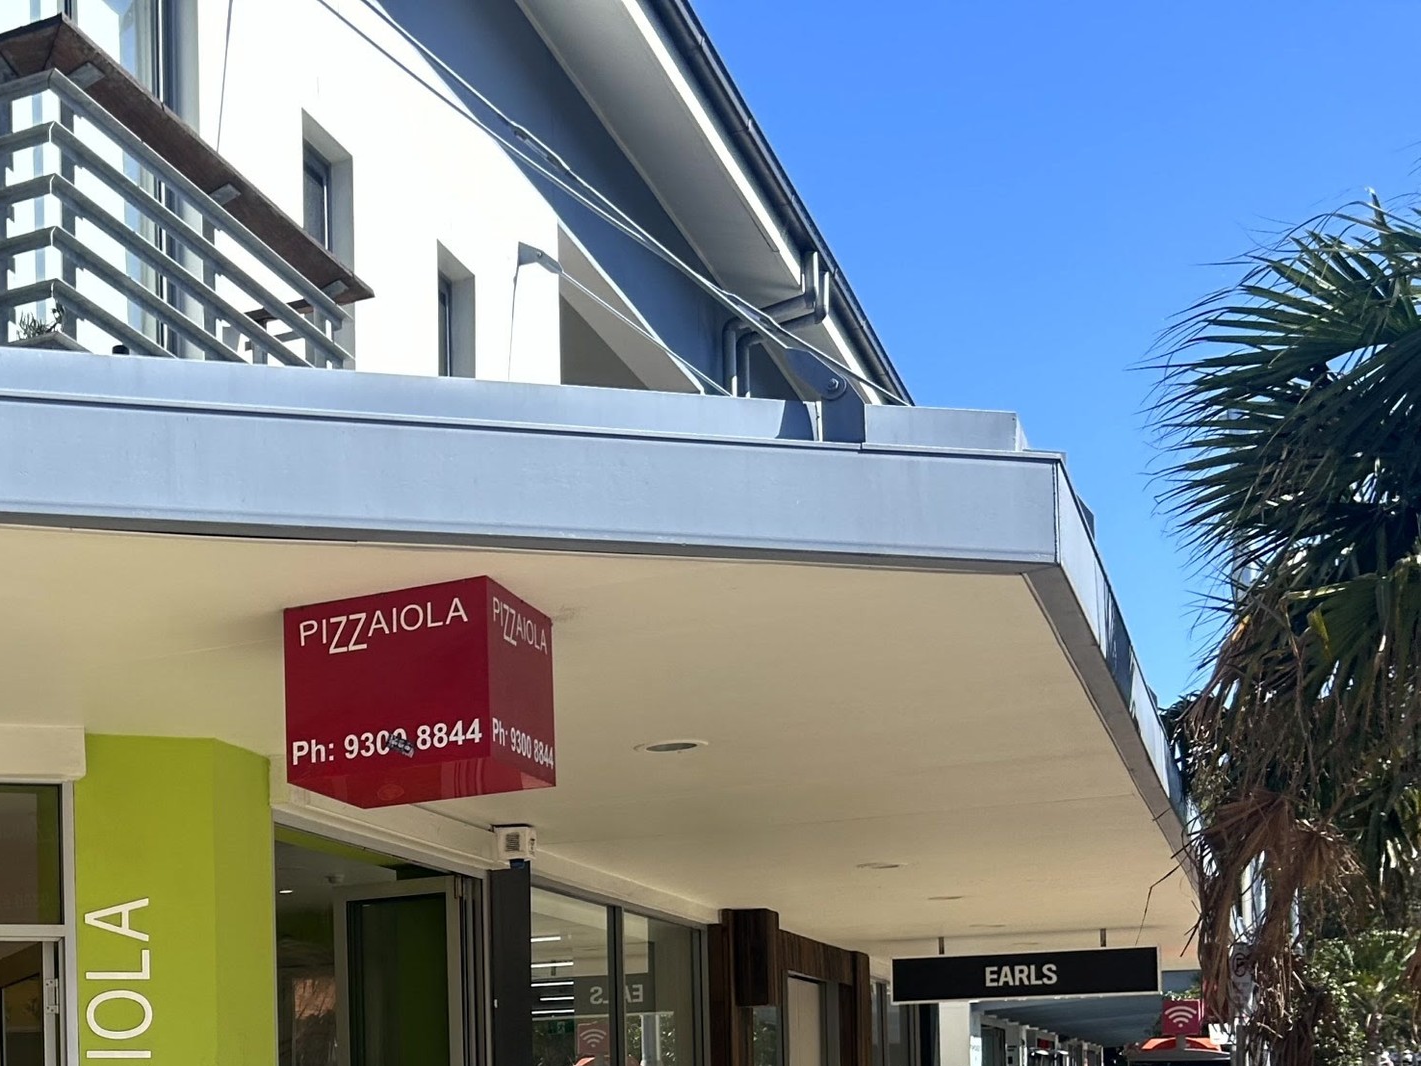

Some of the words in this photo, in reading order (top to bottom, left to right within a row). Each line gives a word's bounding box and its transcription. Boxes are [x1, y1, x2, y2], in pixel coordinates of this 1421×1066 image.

[298, 597, 469, 654] PIZZAIOLA
[492, 596, 548, 655] PIZZAIOLA
[291, 738, 335, 766] Ph:
[415, 717, 483, 750] 8844
[510, 726, 532, 759] 9300
[533, 738, 554, 770] 8844
[984, 963, 1059, 987] EARLS
